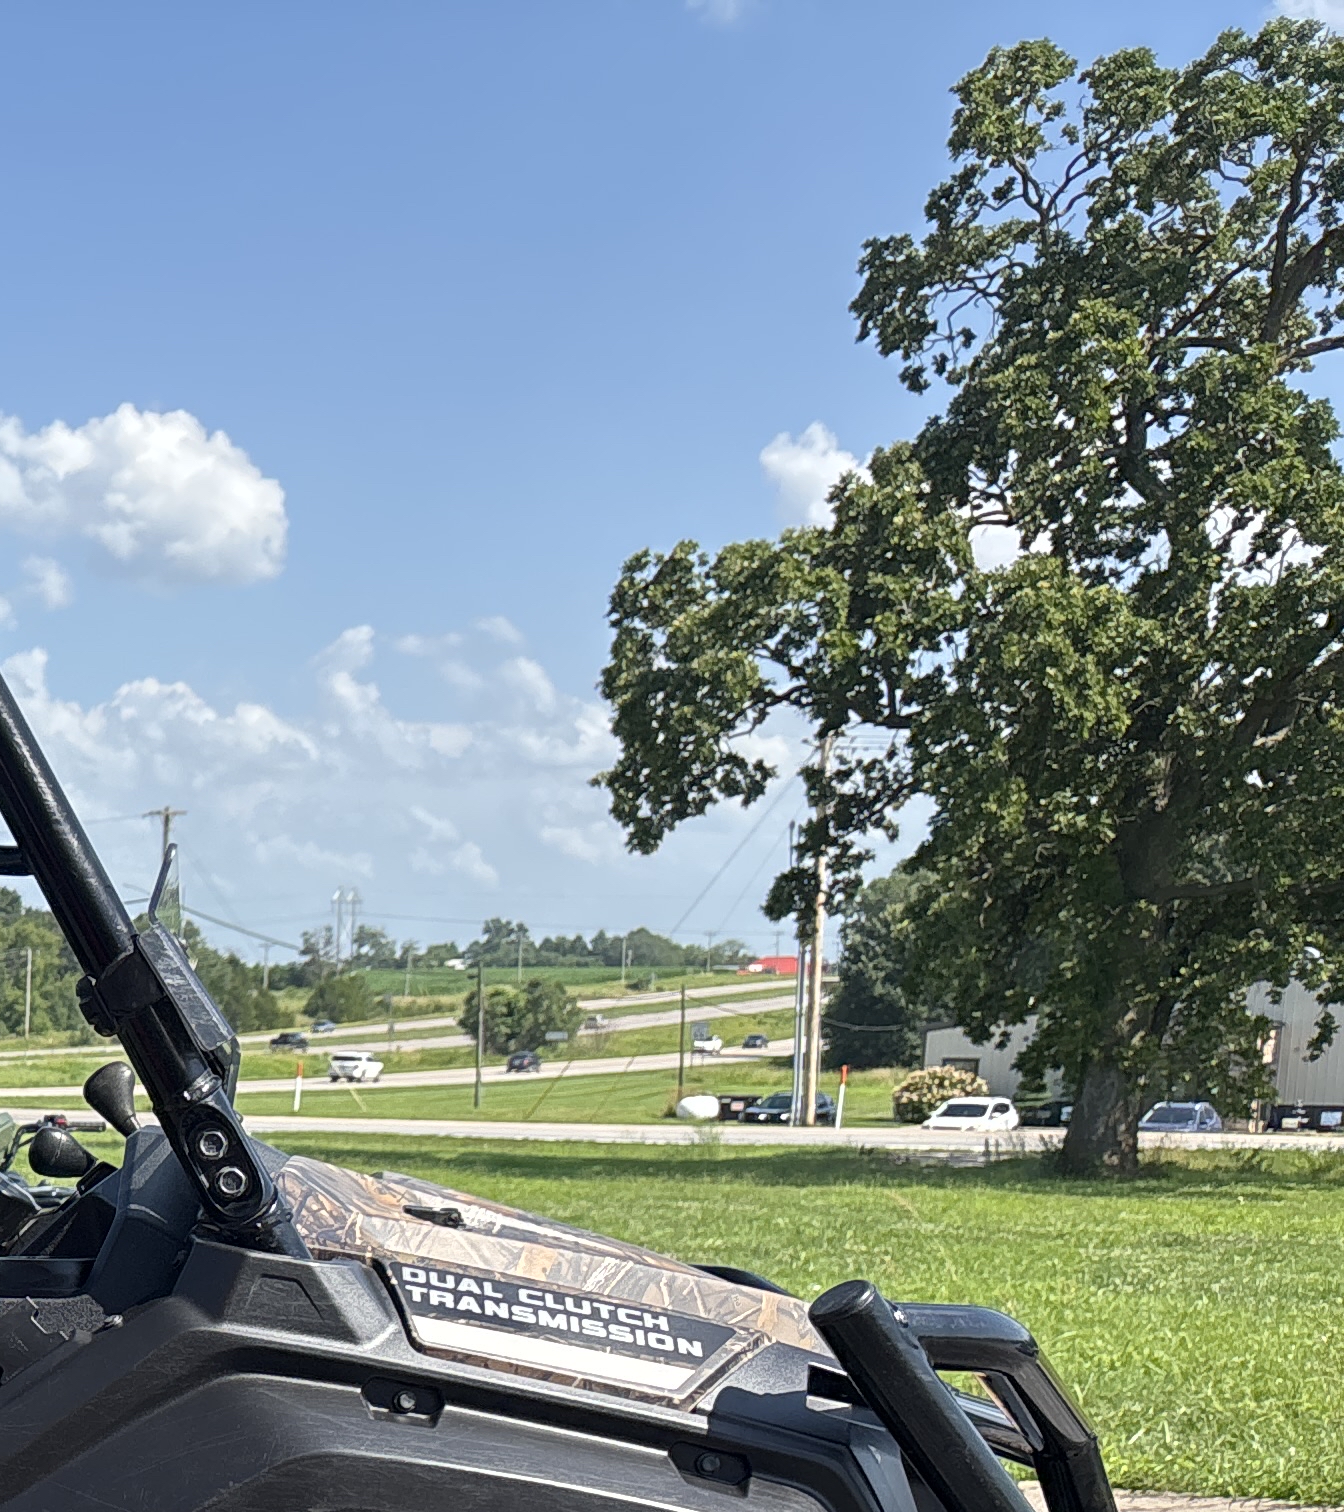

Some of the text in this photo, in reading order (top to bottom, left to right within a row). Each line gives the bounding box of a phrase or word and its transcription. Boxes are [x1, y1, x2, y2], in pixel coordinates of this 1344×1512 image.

[402, 1265, 670, 1334] DUAL CLUTCH
[405, 1285, 704, 1359] TRANSMISSION
